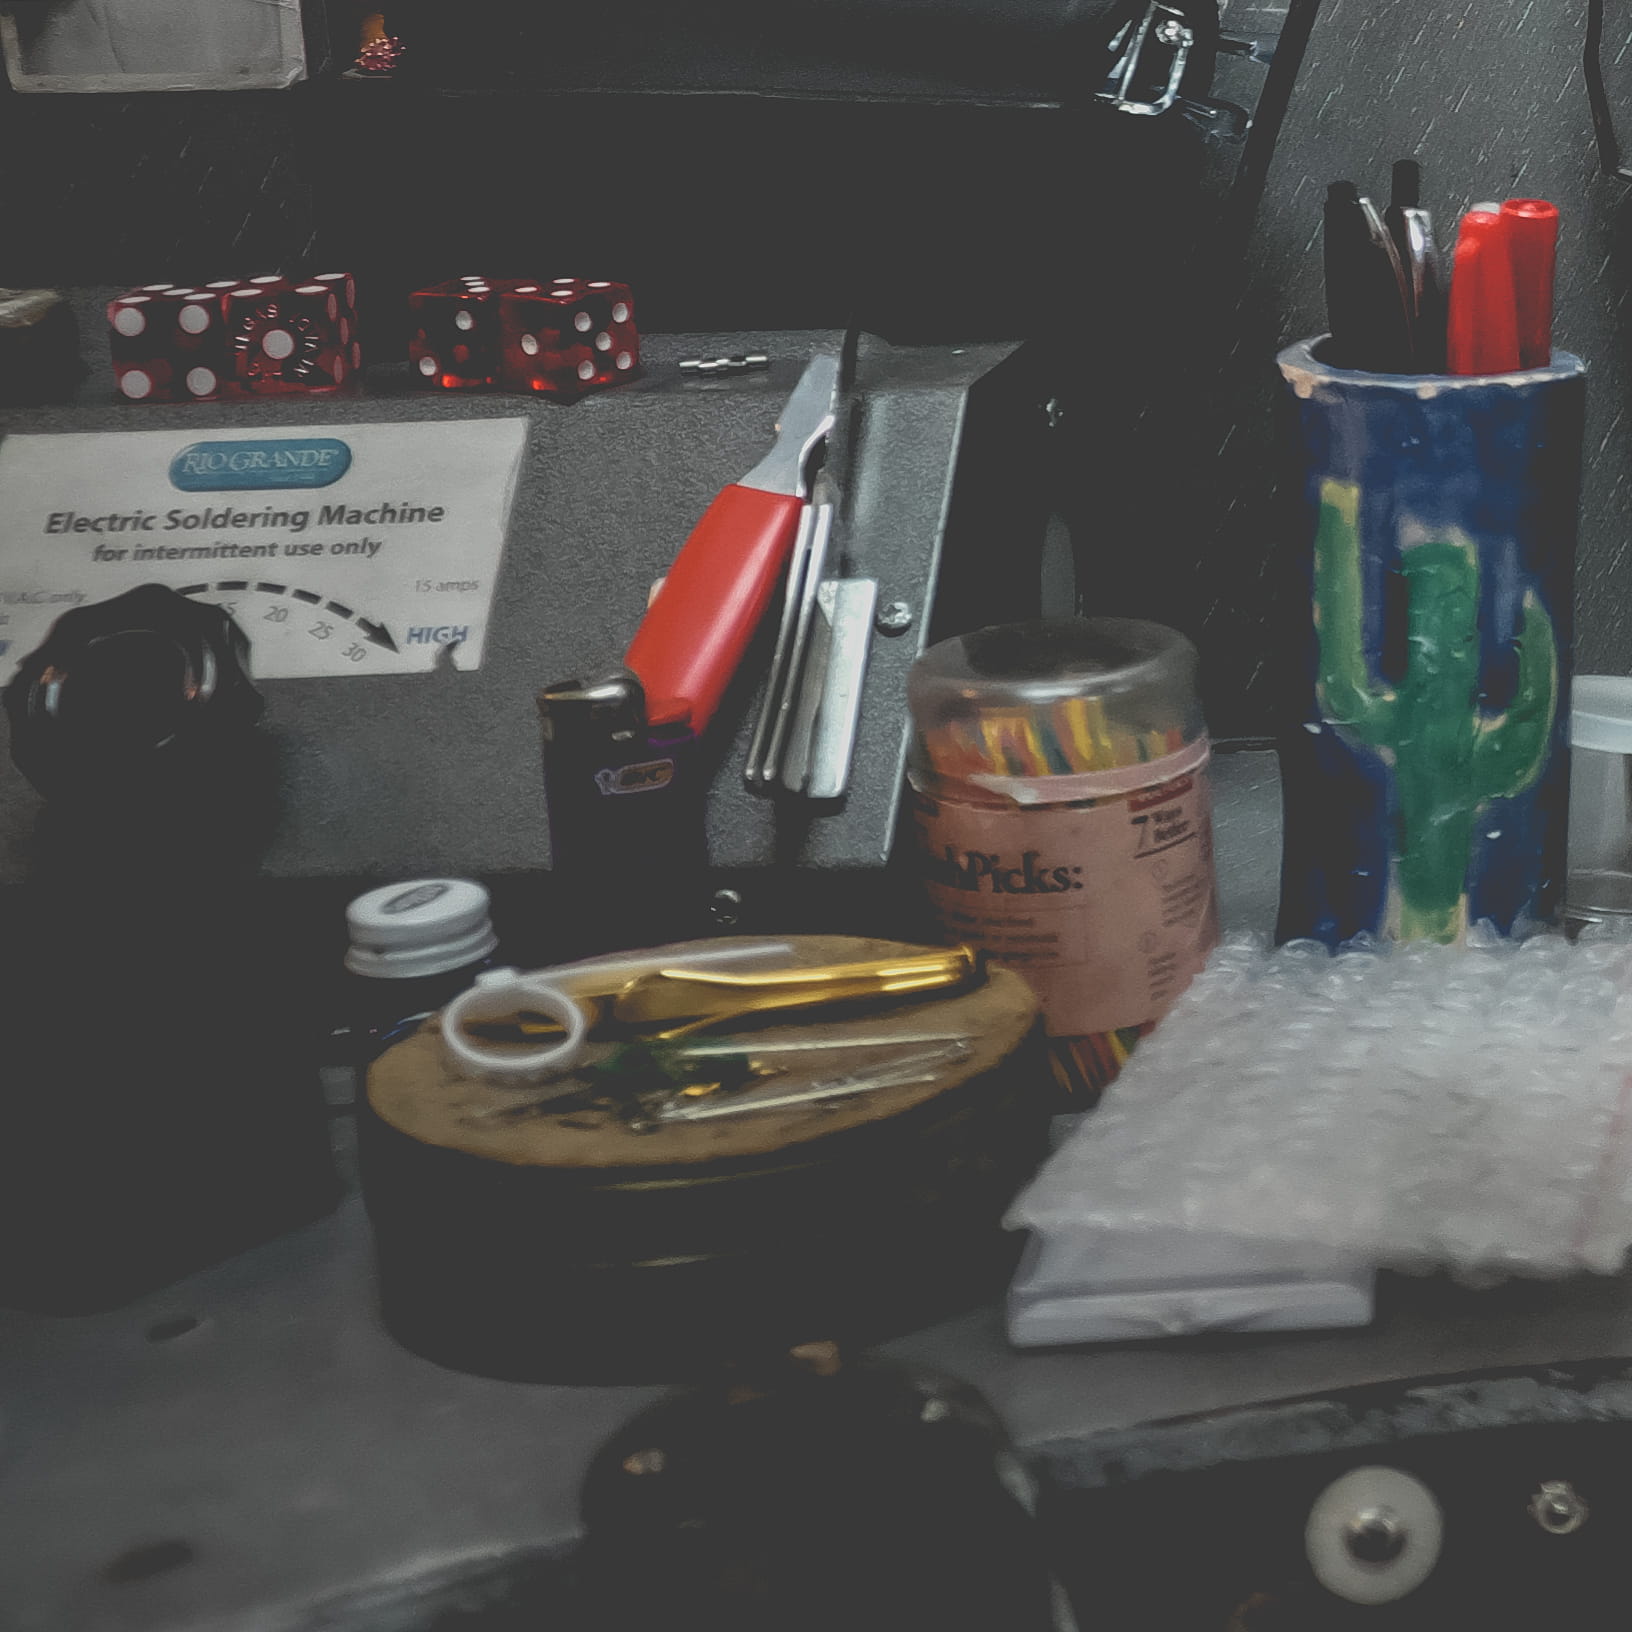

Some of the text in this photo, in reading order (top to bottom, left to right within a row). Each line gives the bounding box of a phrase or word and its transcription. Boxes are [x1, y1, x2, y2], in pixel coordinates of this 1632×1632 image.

[44, 503, 445, 535] Electric Soldering Machine
[92, 537, 382, 564] for intermittent use only
[435, 579, 480, 595] amps
[263, 605, 289, 623] 20
[308, 620, 334, 641] 25
[406, 626, 469, 645] HIGH
[341, 641, 367, 663] 30
